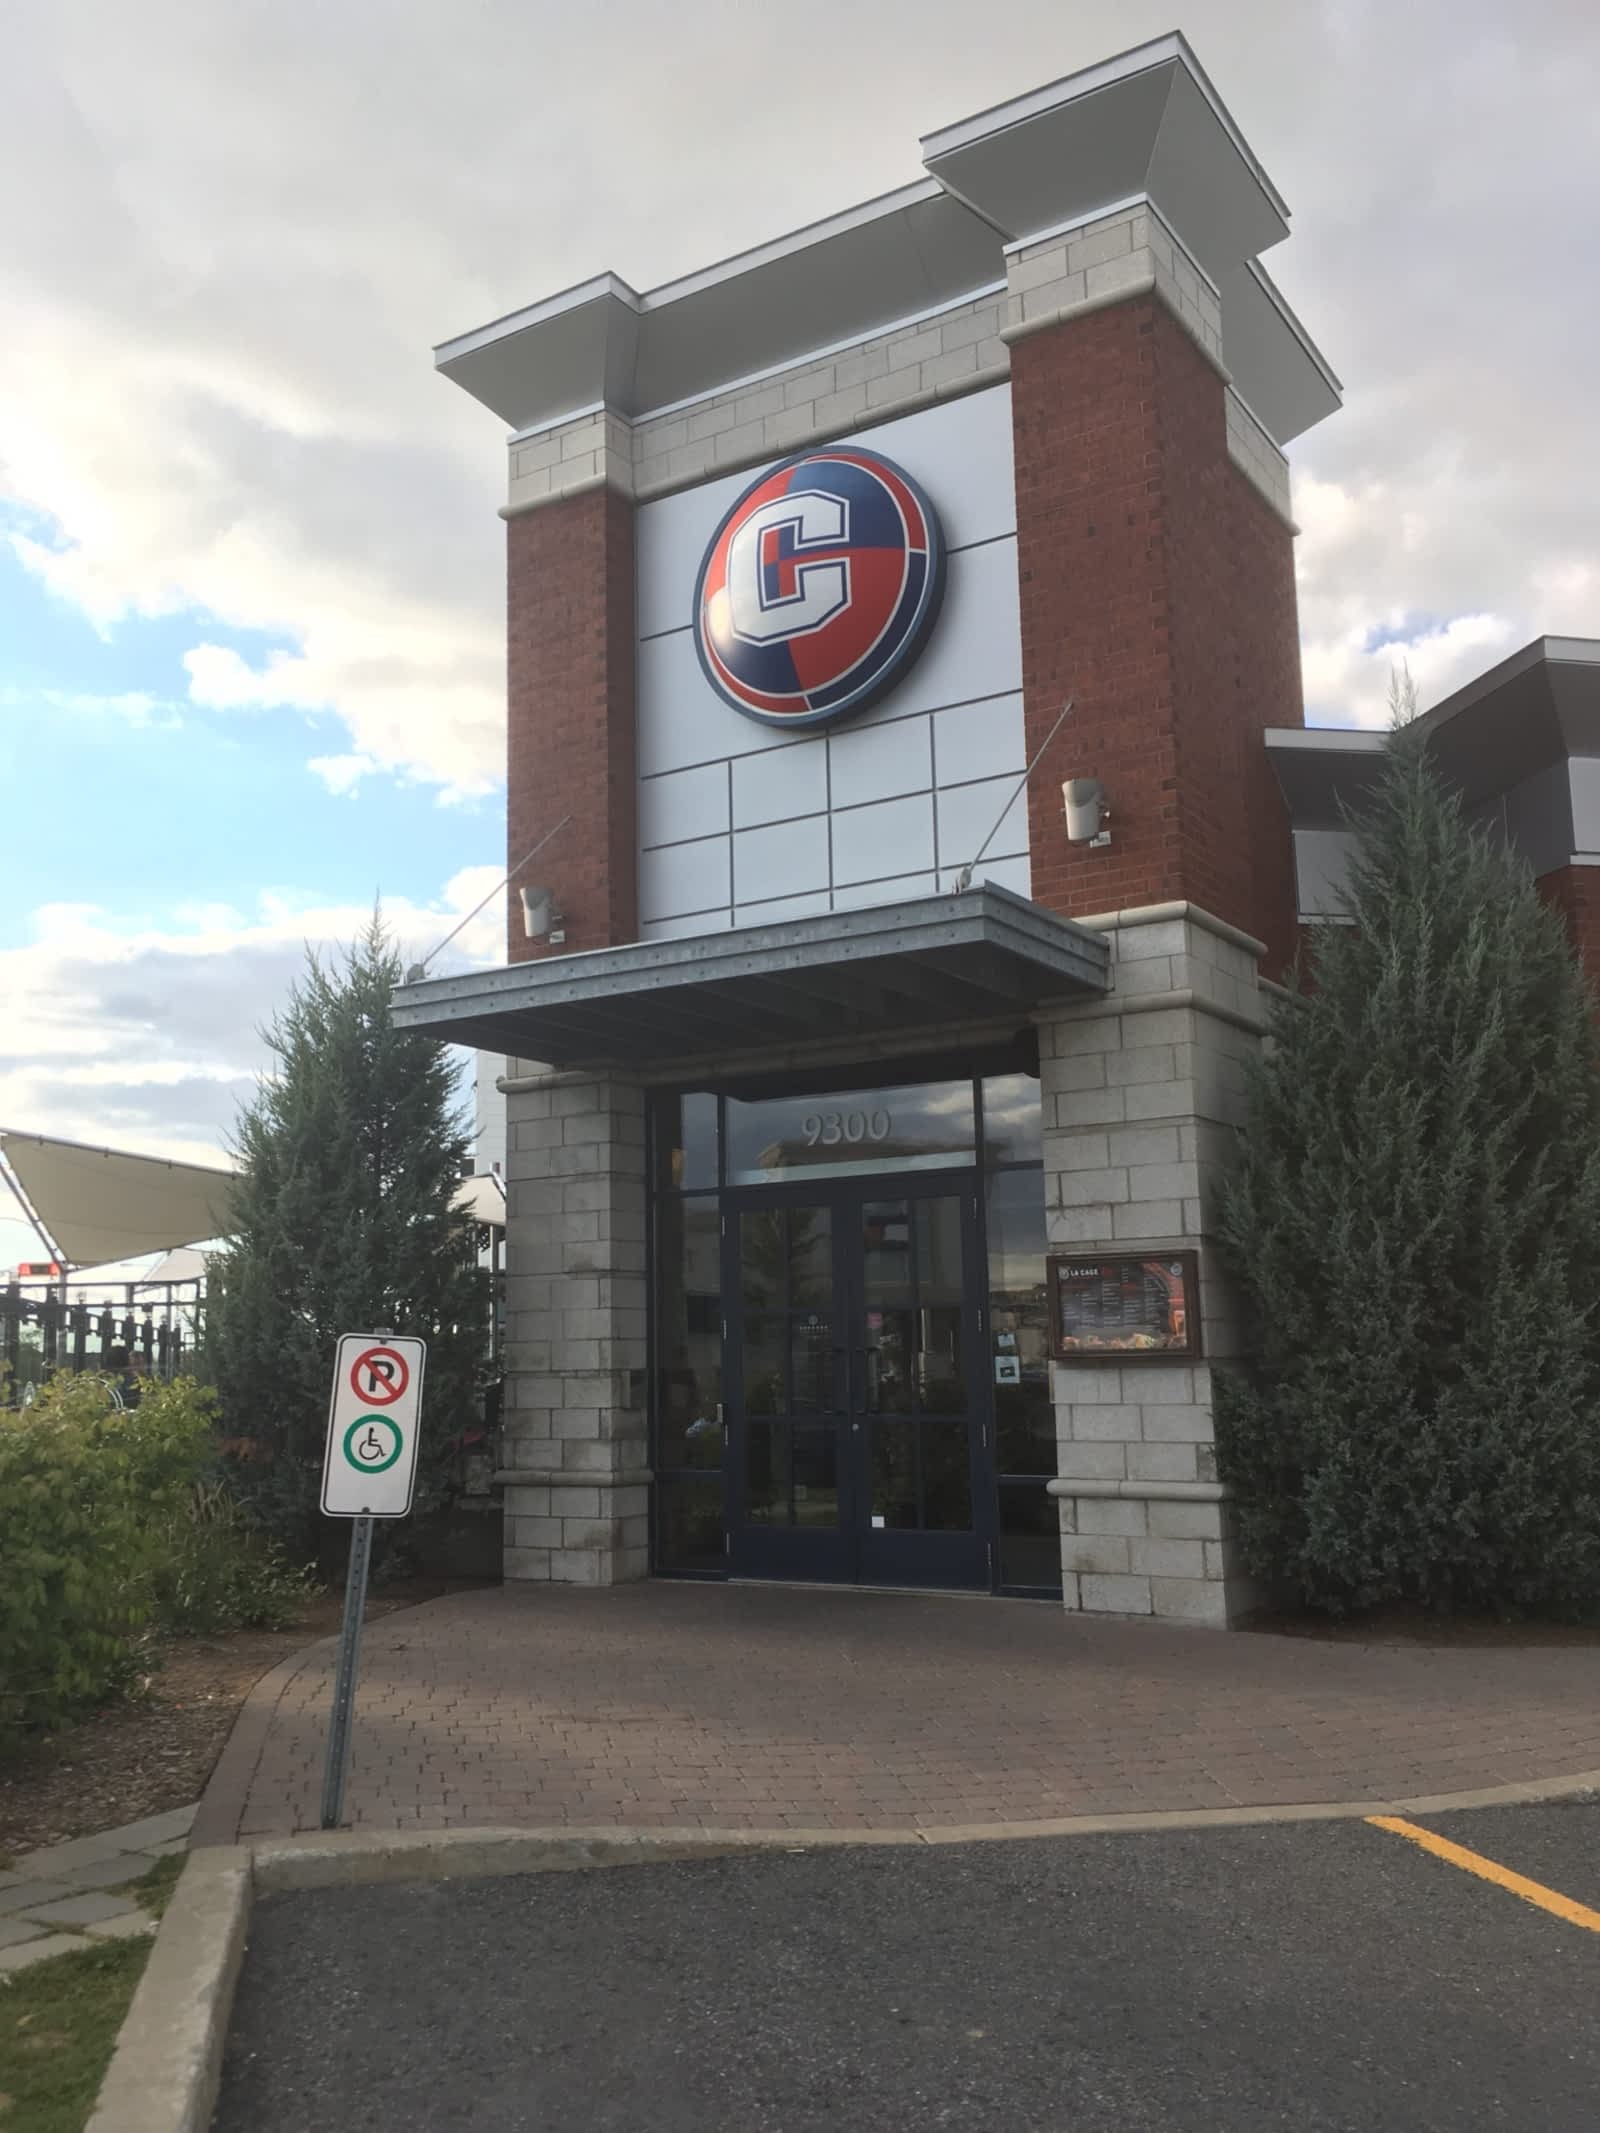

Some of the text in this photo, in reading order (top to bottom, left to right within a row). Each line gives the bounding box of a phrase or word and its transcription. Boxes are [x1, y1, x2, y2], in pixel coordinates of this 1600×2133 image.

[727, 488, 853, 648] C
[801, 1108, 891, 1148] 9300
[368, 1360, 396, 1393] P
